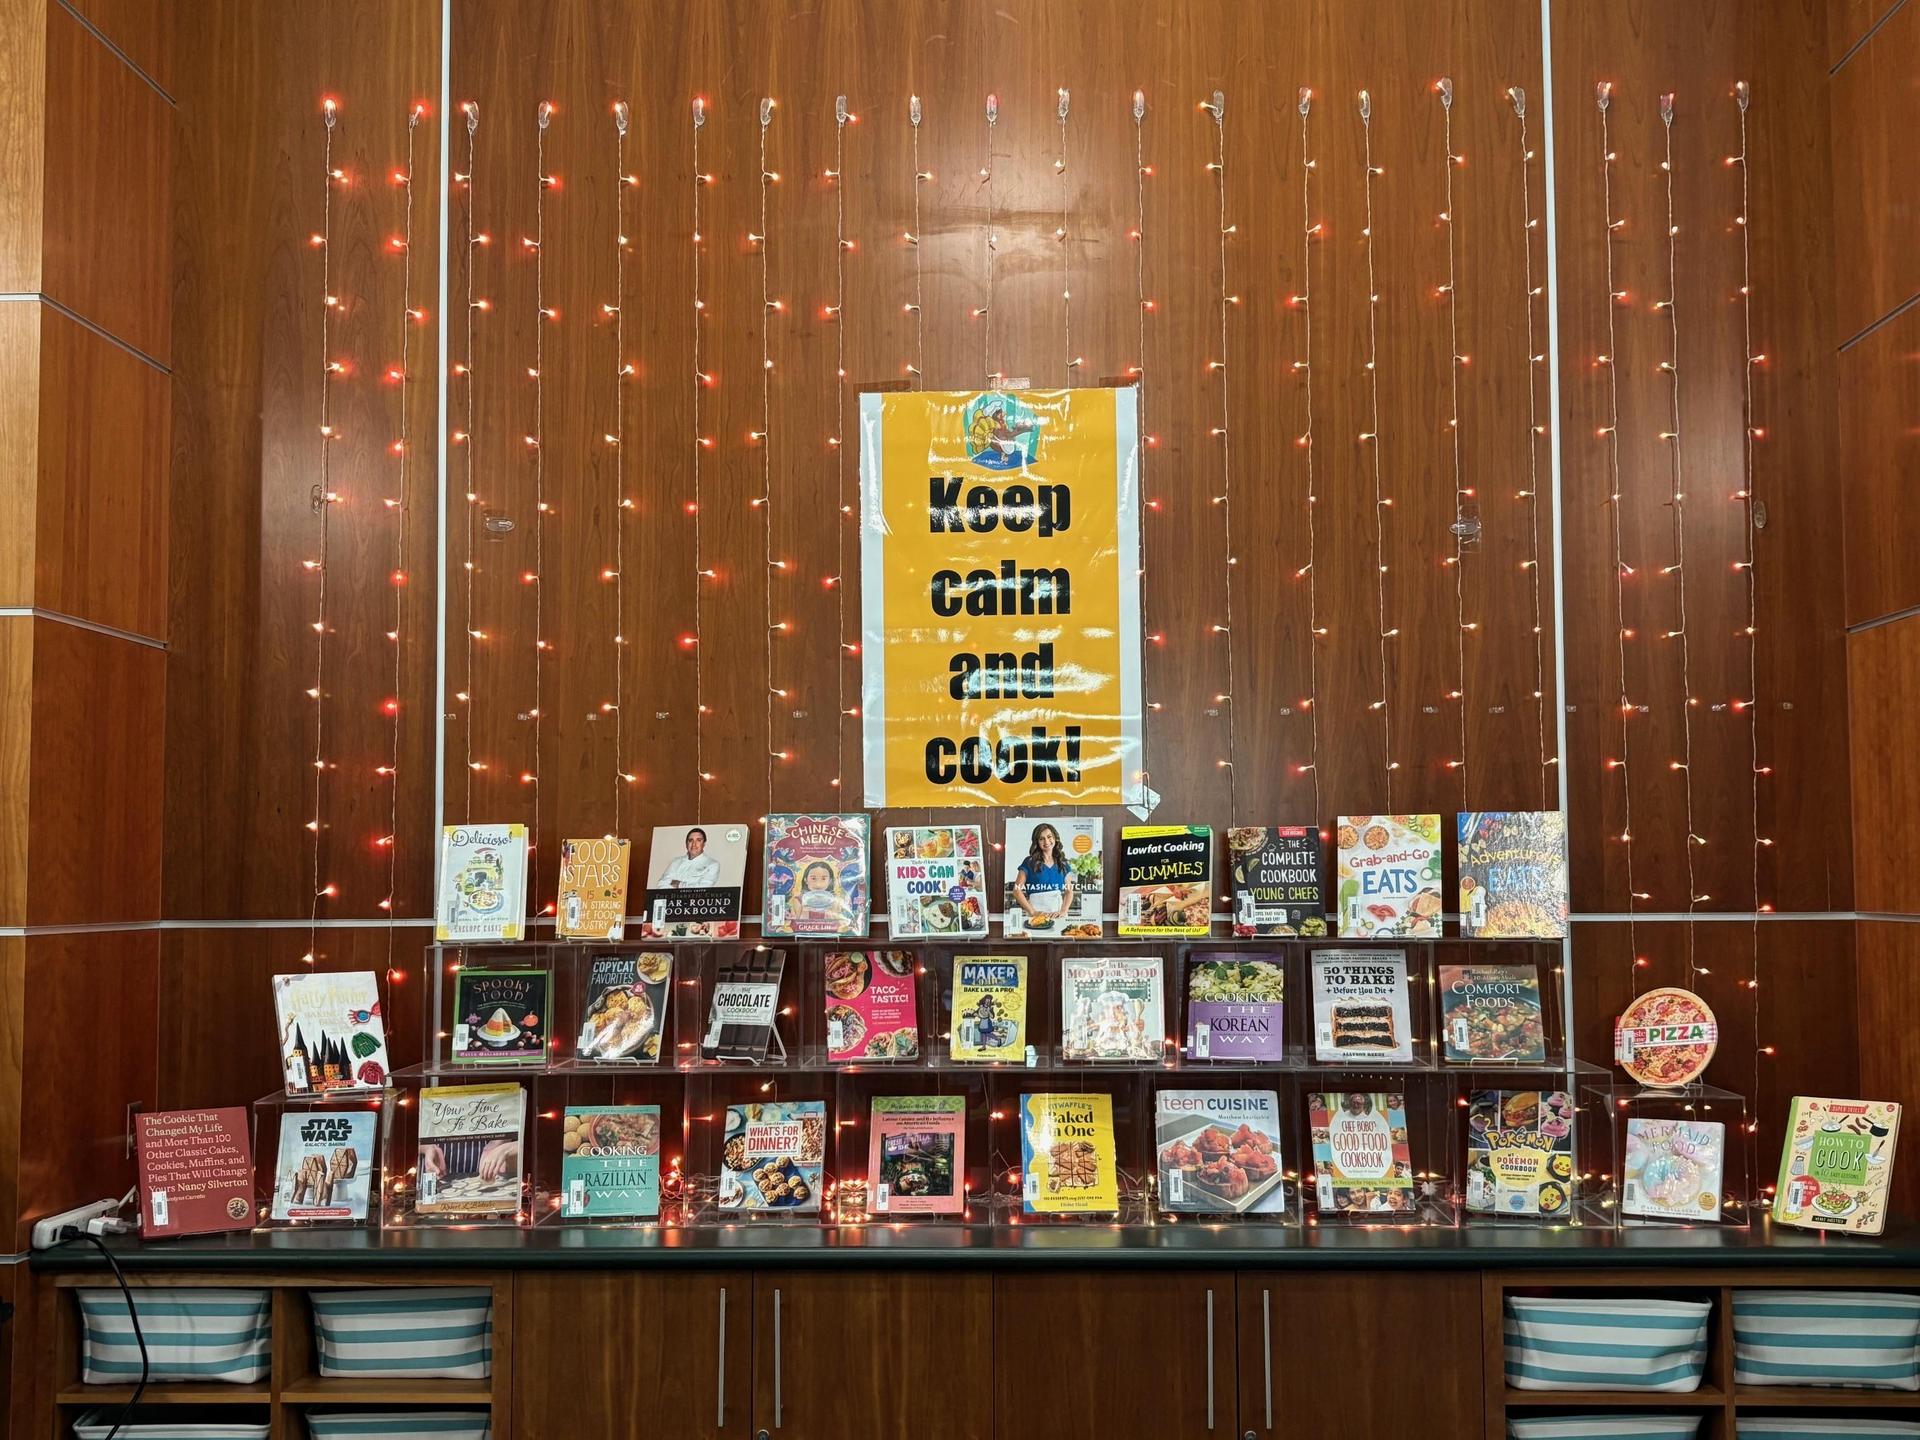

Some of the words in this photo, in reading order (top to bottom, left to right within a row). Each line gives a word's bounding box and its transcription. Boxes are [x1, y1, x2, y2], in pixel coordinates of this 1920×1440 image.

[929, 477, 1071, 537] Keep
[931, 560, 1070, 617] calm
[949, 644, 1054, 700] and
[926, 726, 1081, 784] cook!
[790, 824, 844, 839] CHINESE
[800, 834, 836, 846] MENU
[569, 841, 620, 863] FOOD
[1127, 844, 1161, 855] Lowfat
[1164, 841, 1205, 852] Cooking
[1262, 851, 1316, 865] COMPLETE
[1350, 849, 1430, 868] Grab-and-Go
[566, 864, 620, 887] STARS
[897, 866, 926, 879] KIDS
[928, 865, 954, 878] CAN
[1129, 861, 1203, 881] DUMMIES
[1260, 869, 1317, 883] COOKBOOK
[907, 880, 947, 894] COOK!
[1363, 869, 1418, 894] EATS
[1250, 887, 1284, 900] YOUNG
[1289, 886, 1319, 900] CHEFS
[668, 898, 731, 907] AR-ROUND
[666, 907, 726, 915] OOKBOOK
[593, 961, 635, 973] COPYCAT
[964, 966, 1015, 979] MAKER
[591, 973, 635, 984] FAVORITES
[1324, 975, 1345, 985] TO
[1350, 975, 1395, 984] BAKE
[473, 979, 534, 994] SPOOKY
[870, 986, 899, 994] TACO-
[1359, 987, 1372, 995] You
[1452, 981, 1521, 995] COMFORT
[482, 989, 524, 1002] FOOD
[717, 994, 771, 1007] CHOCOLATE
[871, 995, 909, 1004] TASTIC!
[1205, 992, 1270, 1002] COOKING
[1466, 995, 1515, 1008] FOODS
[1210, 1018, 1269, 1032] KOREAN
[1649, 1025, 1703, 1041] PIZZA
[1163, 1096, 1204, 1111] teen
[1207, 1099, 1268, 1111] CUISINE
[144, 1117, 162, 1125] The
[163, 1114, 196, 1124] Cookie
[196, 1113, 218, 1121] That
[432, 1102, 464, 1125] Your
[468, 1099, 501, 1116] Time
[146, 1126, 187, 1137] Changed
[189, 1125, 204, 1135] My
[205, 1123, 223, 1133] Life
[301, 1119, 352, 1130] STAR
[447, 1116, 467, 1133] To
[469, 1114, 508, 1131] Bake
[1342, 1120, 1355, 1132] CHEF
[300, 1130, 352, 1142] WARS
[750, 1126, 780, 1137] WHAT'S
[782, 1126, 799, 1135] FOR
[1065, 1125, 1095, 1137] One
[1637, 1122, 1710, 1145] MERMAID
[145, 1140, 163, 1148] and
[164, 1138, 189, 1147] More
[190, 1136, 214, 1145] Than
[215, 1134, 231, 1143] 100
[748, 1136, 798, 1151] DINNER?
[1333, 1134, 1360, 1152] GOOD
[1362, 1134, 1388, 1151] FOOD
[1652, 1140, 1696, 1155] FOOD
[1820, 1137, 1844, 1148] HOW
[1848, 1139, 1864, 1149] TO
[146, 1150, 174, 1159] Other
[175, 1148, 208, 1158] Classic
[209, 1146, 239, 1154] Cakes,
[580, 1146, 647, 1157] COOKING
[147, 1162, 187, 1171] Cookies,
[189, 1157, 227, 1168] Muffins,
[228, 1155, 245, 1164] and
[1341, 1152, 1384, 1168] COOKBOOK
[1816, 1149, 1866, 1172] COOK
[148, 1173, 167, 1182] Pies
[168, 1172, 191, 1181] That
[192, 1169, 211, 1178] Will
[212, 1168, 248, 1177] Change
[149, 1184, 176, 1192] Yours
[177, 1182, 207, 1191] Nancy
[208, 1179, 248, 1189] Silverton
